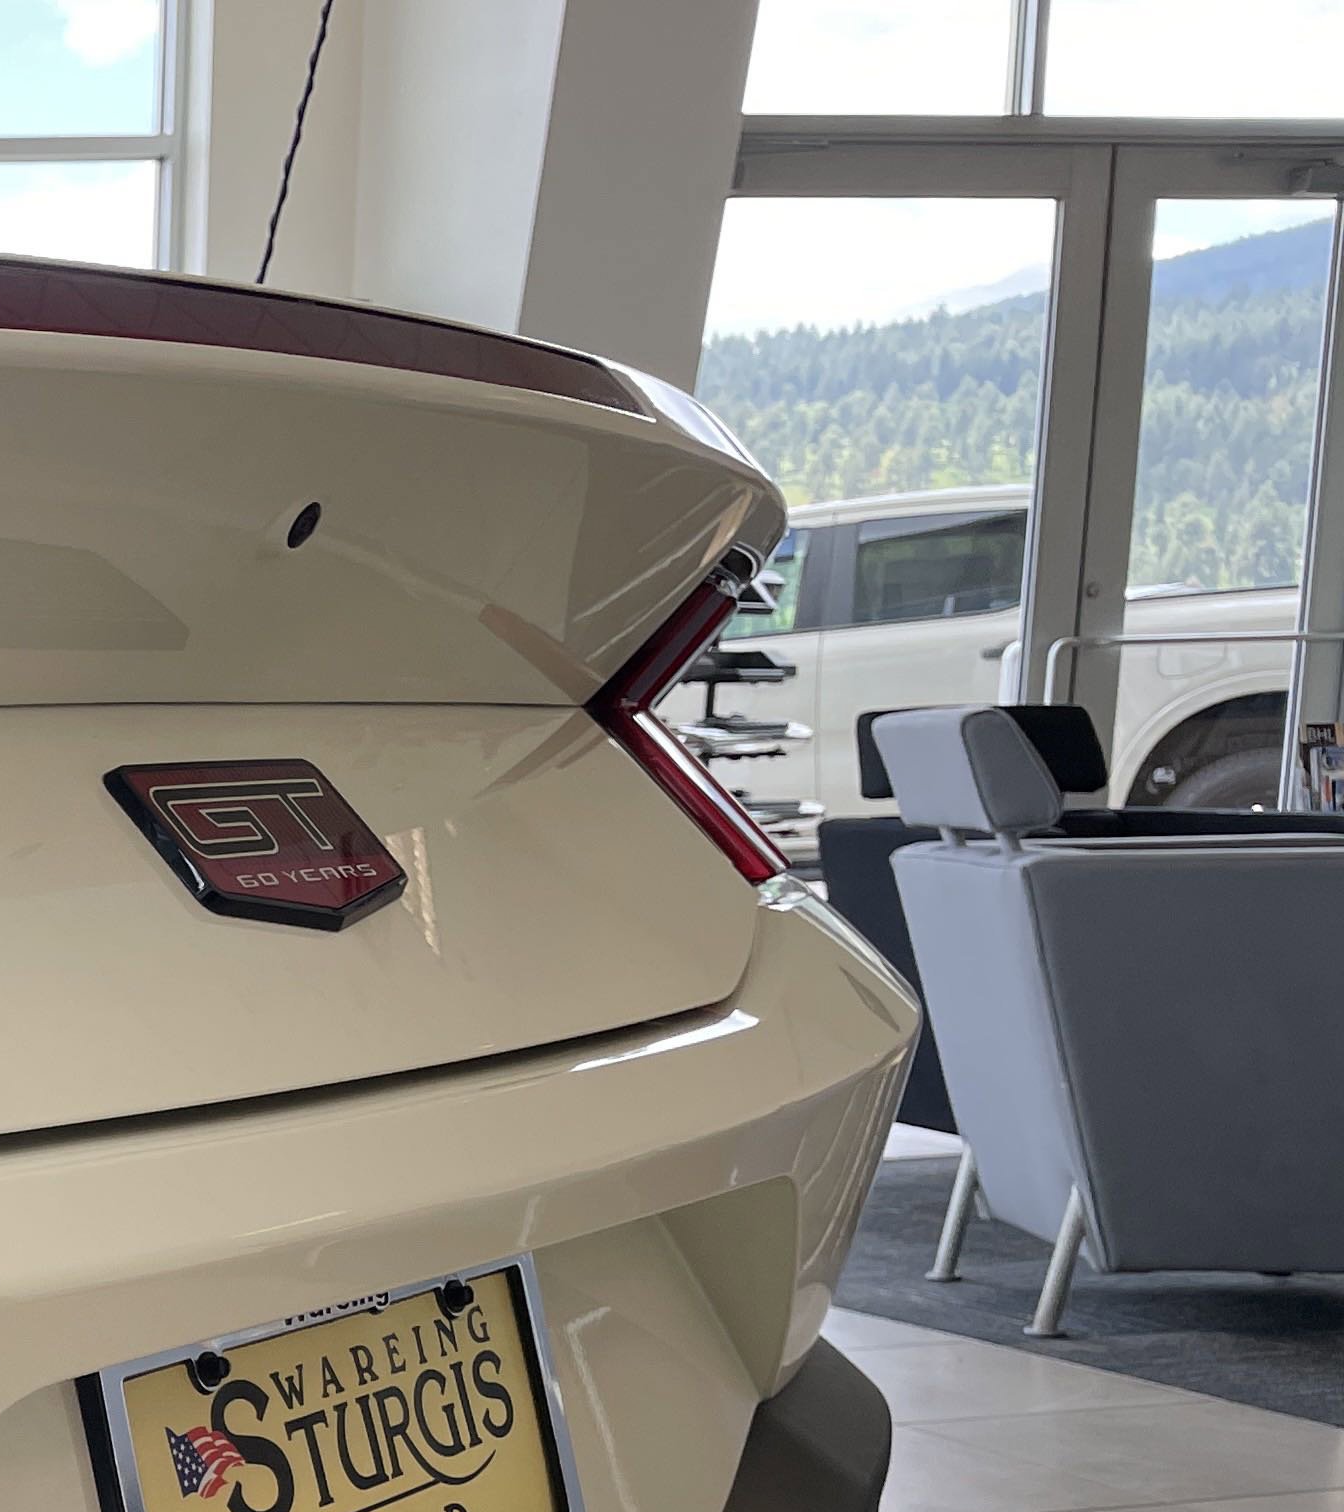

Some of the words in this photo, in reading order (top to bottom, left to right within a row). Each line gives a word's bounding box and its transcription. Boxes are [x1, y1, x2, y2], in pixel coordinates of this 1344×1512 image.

[150, 778, 334, 859] GT
[236, 871, 280, 888] 60
[282, 863, 377, 884] YEARS
[269, 1304, 491, 1410] WAREING
